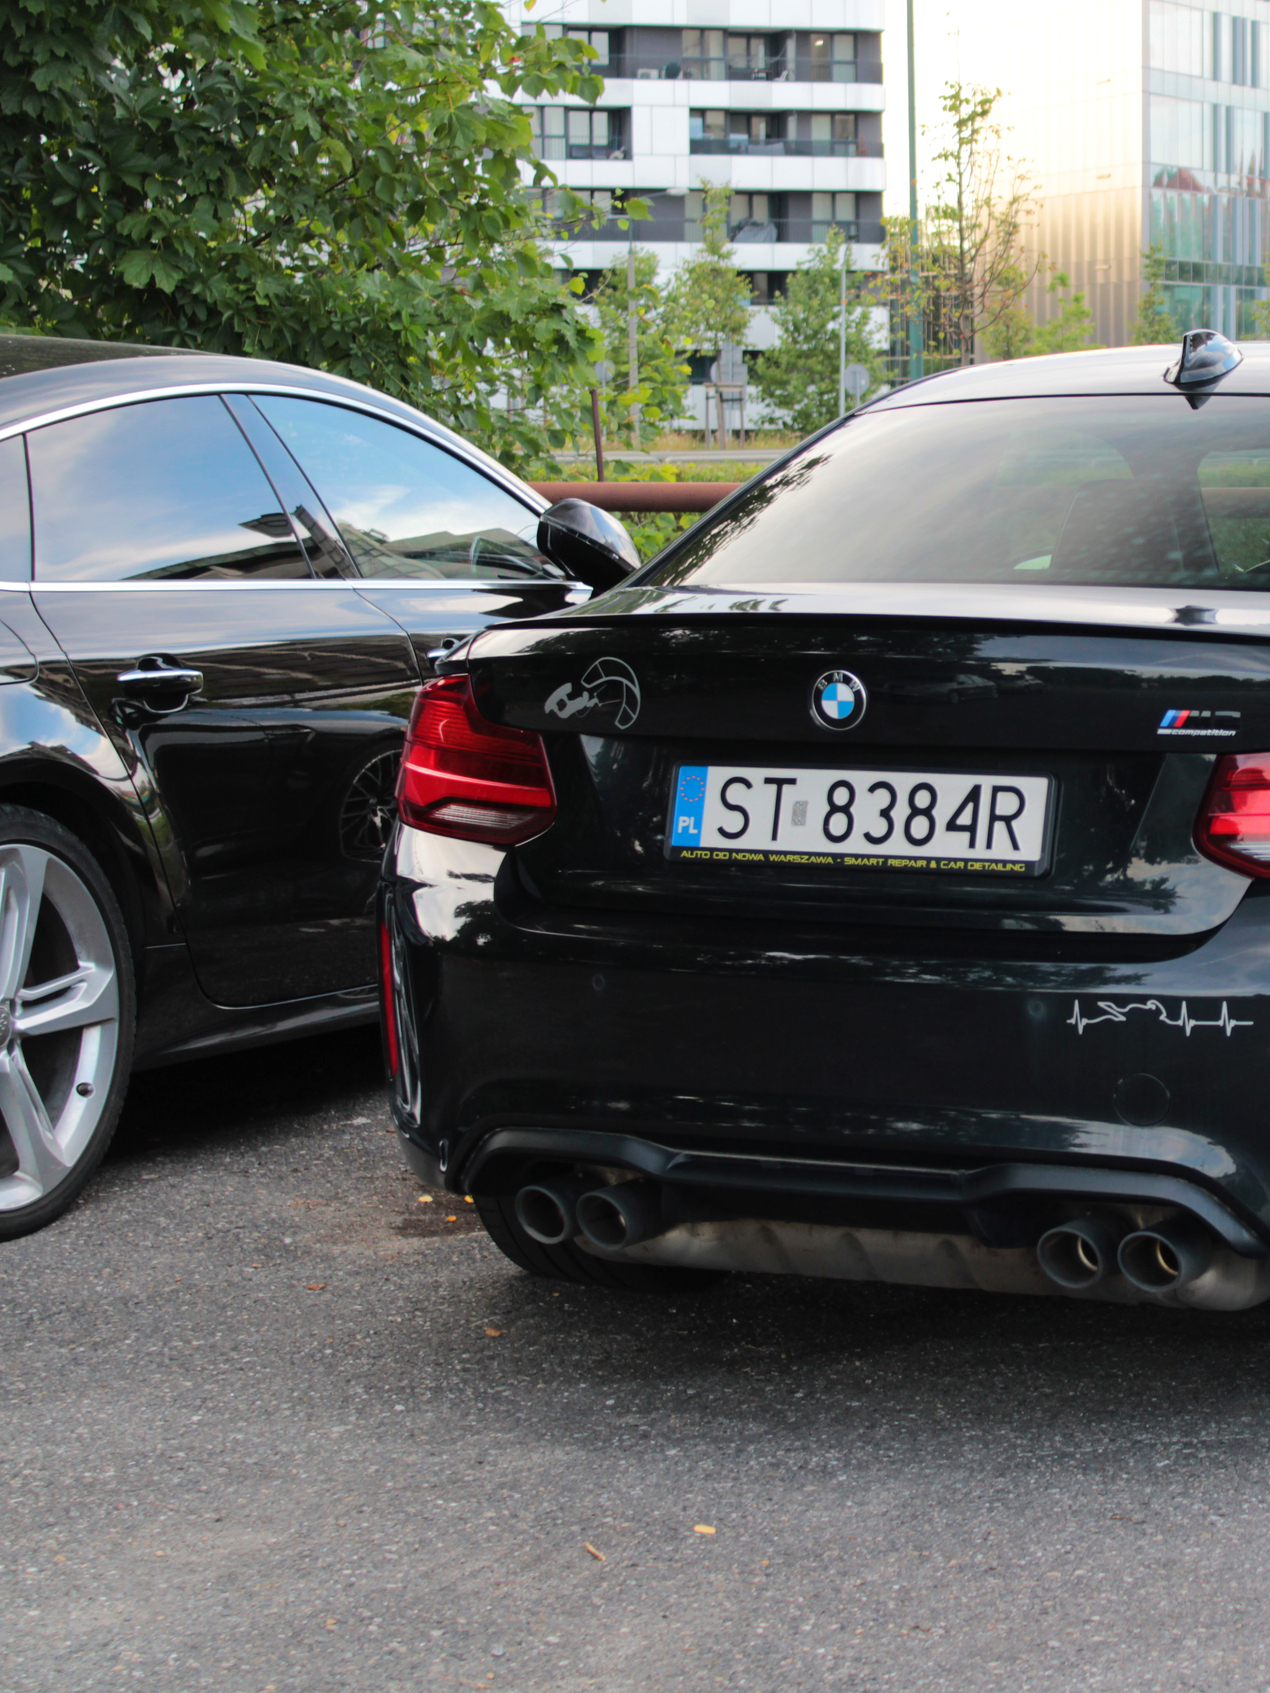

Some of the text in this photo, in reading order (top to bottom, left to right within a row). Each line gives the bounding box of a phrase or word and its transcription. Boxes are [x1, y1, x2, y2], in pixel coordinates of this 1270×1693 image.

[817, 672, 861, 692] BMW
[1171, 728, 1237, 737] competition
[717, 776, 1026, 851] ST 8384R
[677, 816, 698, 835] PL
[680, 850, 711, 859] AUTO
[712, 851, 730, 860] OD
[731, 852, 765, 861] NOWA
[768, 854, 834, 864] WARSZAWA
[844, 857, 885, 866] SMART
[887, 859, 927, 868] REPAIR
[929, 860, 938, 869] &
[940, 860, 965, 869] CAR
[967, 861, 1026, 872] DETAILING
